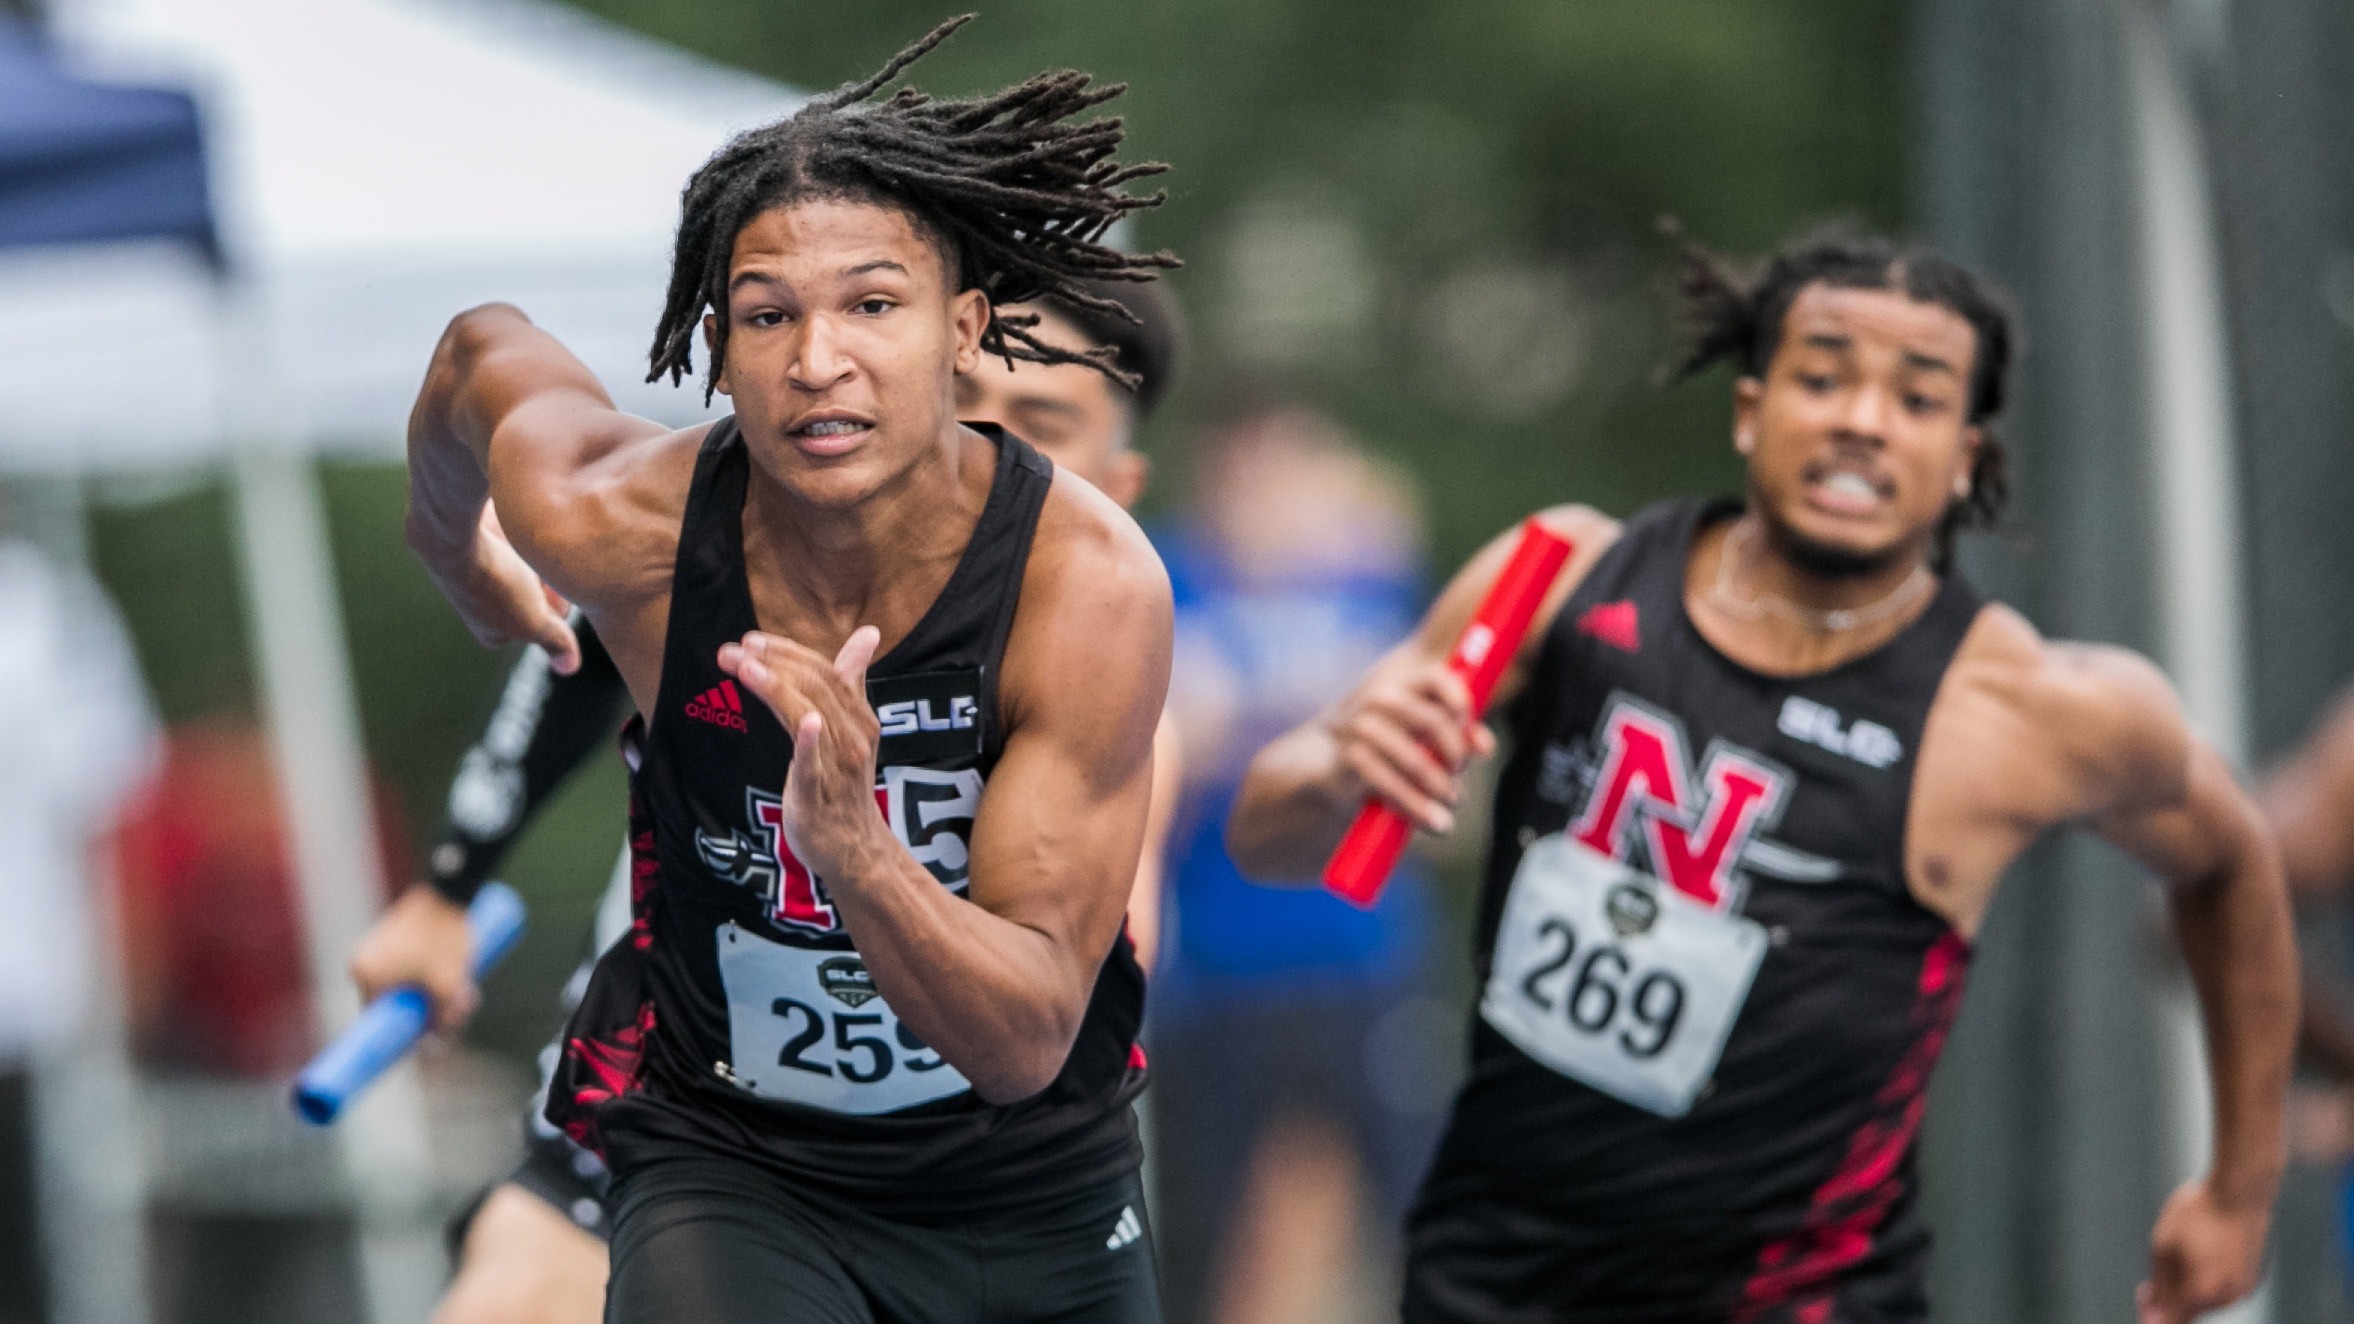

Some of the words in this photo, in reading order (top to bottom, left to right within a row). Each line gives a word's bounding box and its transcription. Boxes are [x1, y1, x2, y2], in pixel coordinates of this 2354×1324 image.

[685, 702, 748, 734] adidas
[1566, 700, 1778, 912] N
[1520, 914, 1687, 1060] 269
